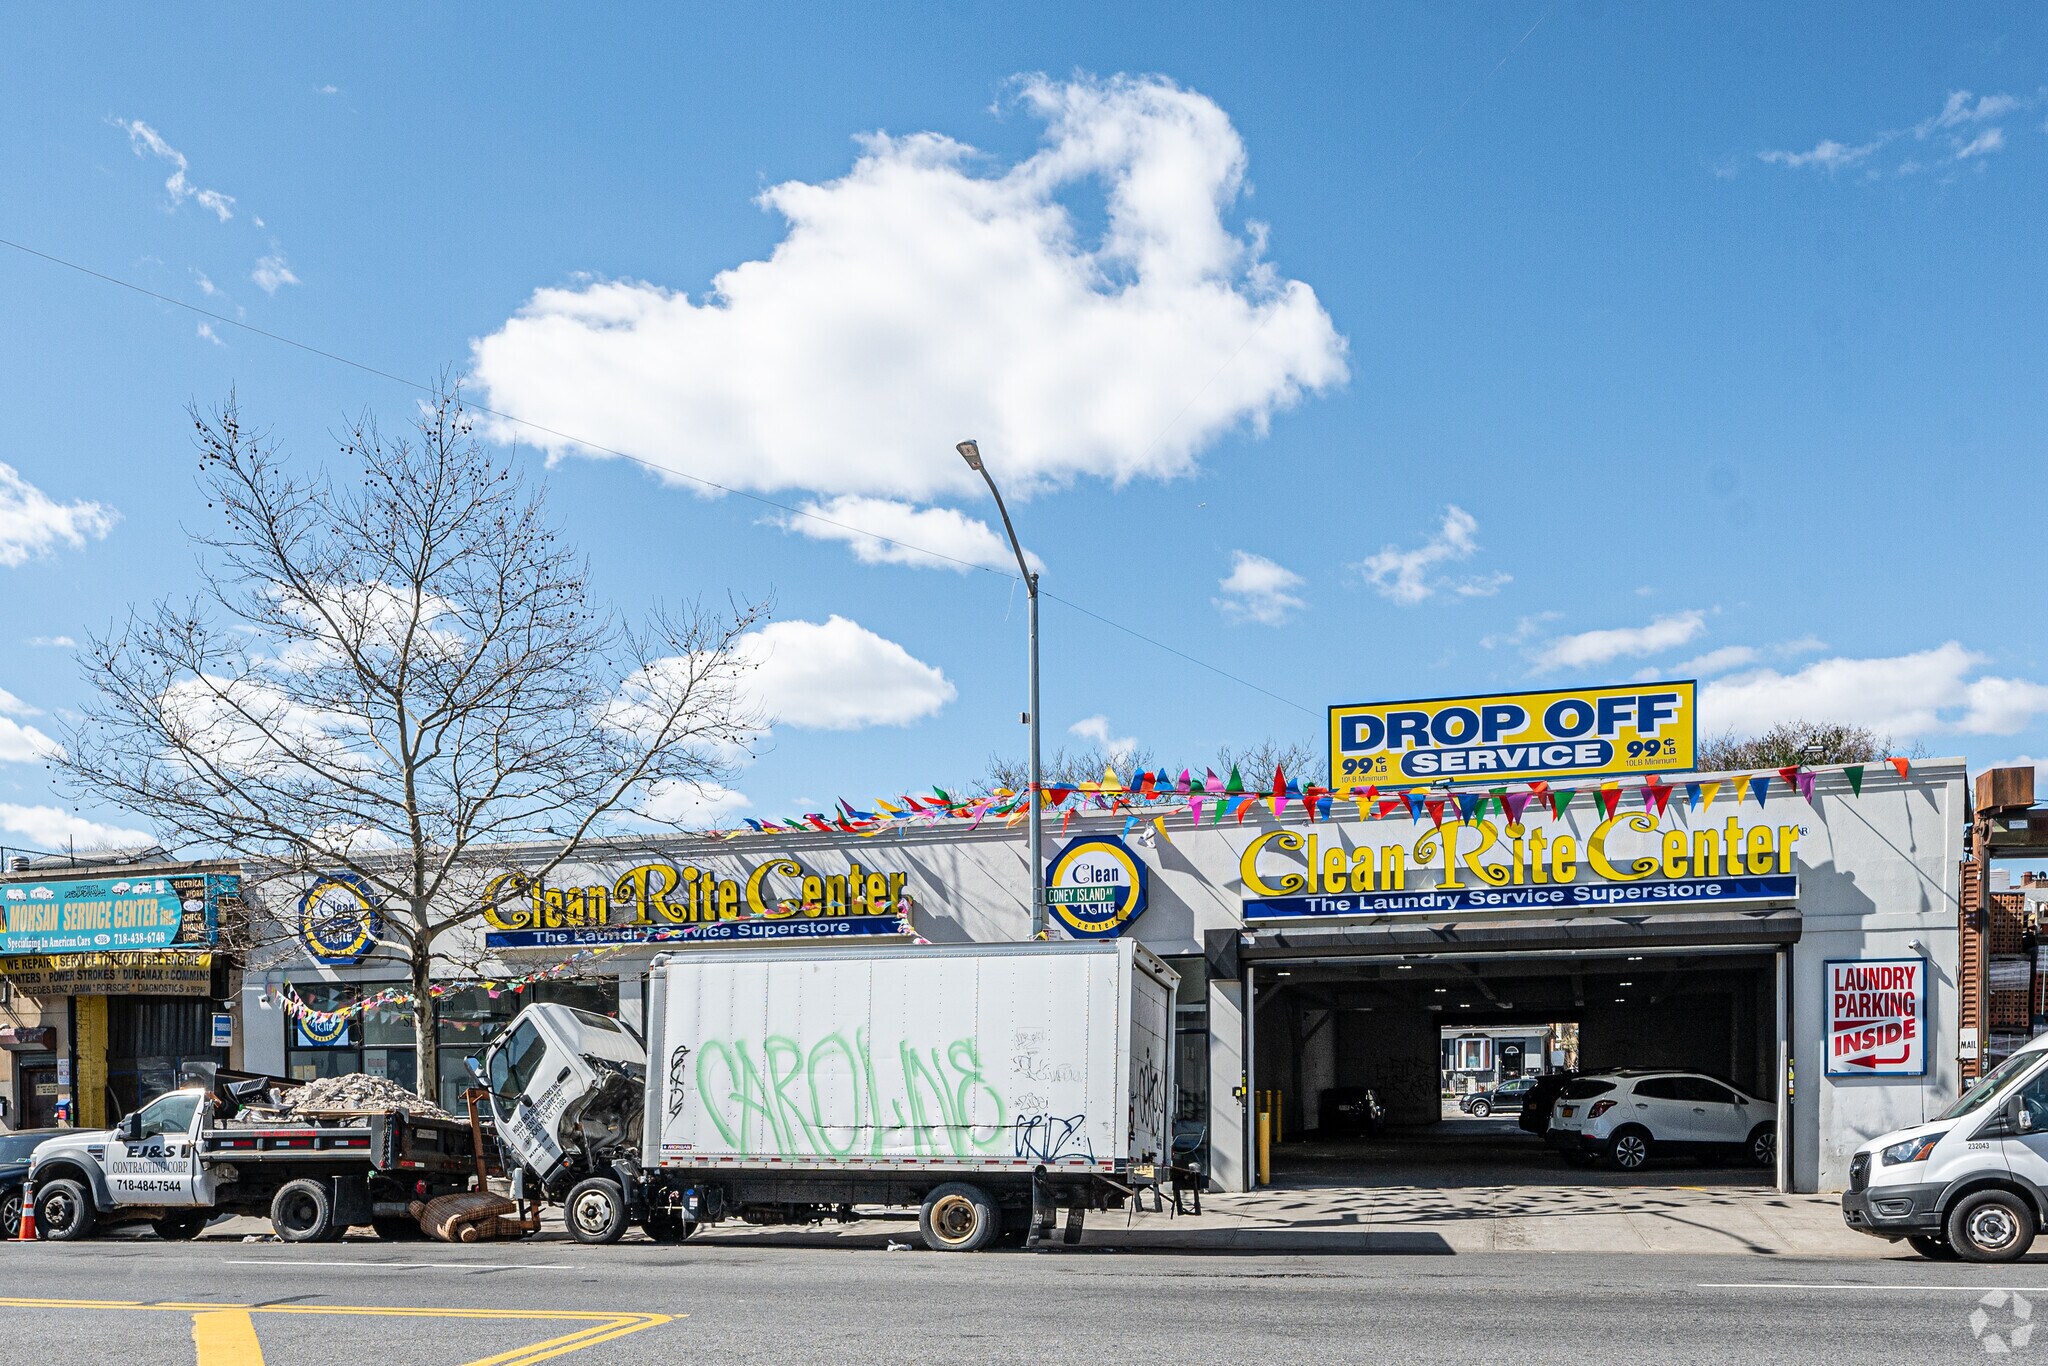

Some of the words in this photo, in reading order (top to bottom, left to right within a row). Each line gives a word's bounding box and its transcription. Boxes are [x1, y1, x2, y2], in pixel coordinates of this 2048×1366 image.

[1340, 704, 1528, 753] DROP
[1543, 693, 1680, 741] OFF
[1663, 747, 1677, 755] LB
[1411, 744, 1602, 774] SERVICE
[1644, 757, 1677, 766] Minimum
[1358, 775, 1388, 783] Minimum
[1239, 829, 1405, 898] Clean
[1413, 819, 1577, 890] Rite
[1588, 811, 1800, 883] Center
[1072, 863, 1119, 884] Clean
[482, 871, 608, 930] Clean
[613, 863, 742, 926] Rite
[746, 858, 908, 920] Center
[1048, 889, 1075, 903] CONEY
[1077, 887, 1106, 902] ISLAND
[1305, 897, 1354, 914] The
[1359, 893, 1458, 913] Laundry
[1468, 887, 1565, 907] Service
[1577, 880, 1722, 903] Superstore
[9, 904, 59, 932] MOHSAN
[63, 901, 112, 931] SERVICE
[114, 898, 158, 928] CENTER
[183, 913, 202, 922] CHECK
[533, 931, 568, 944] The
[737, 919, 851, 937] Superstore
[1077, 920, 1116, 931] center
[49, 935, 76, 948] American
[77, 935, 91, 946] Cars
[114, 932, 165, 945] 718-438-6748
[6, 959, 20, 970] WE
[22, 957, 53, 969] REPAIR
[60, 955, 97, 967] SERVICE
[48, 969, 75, 982] POWER
[77, 968, 115, 981] STROKES
[123, 969, 163, 980] DURAMAX
[1835, 966, 1916, 991] LAUNDRY
[52, 983, 68, 994] BENZ
[96, 983, 130, 993] PORSCHE
[138, 983, 184, 993] DIAGNOSTICS
[1834, 991, 1916, 1018] PARKING
[1834, 1018, 1917, 1057] INSIDE
[1961, 1041, 1976, 1049] MAIL
[511, 1120, 523, 1134] HOLD
[527, 1087, 554, 1115] DISTRIBUTORS
[517, 1128, 527, 1139] 777
[523, 1116, 537, 1131] KENT
[541, 1096, 557, 1112] SUITE
[127, 1145, 176, 1158] EJ&S
[1967, 1142, 1990, 1150] 232043
[112, 1161, 166, 1174] CONTRACTING
[167, 1161, 188, 1173] CORP
[116, 1179, 181, 1192] 718-484-7544
